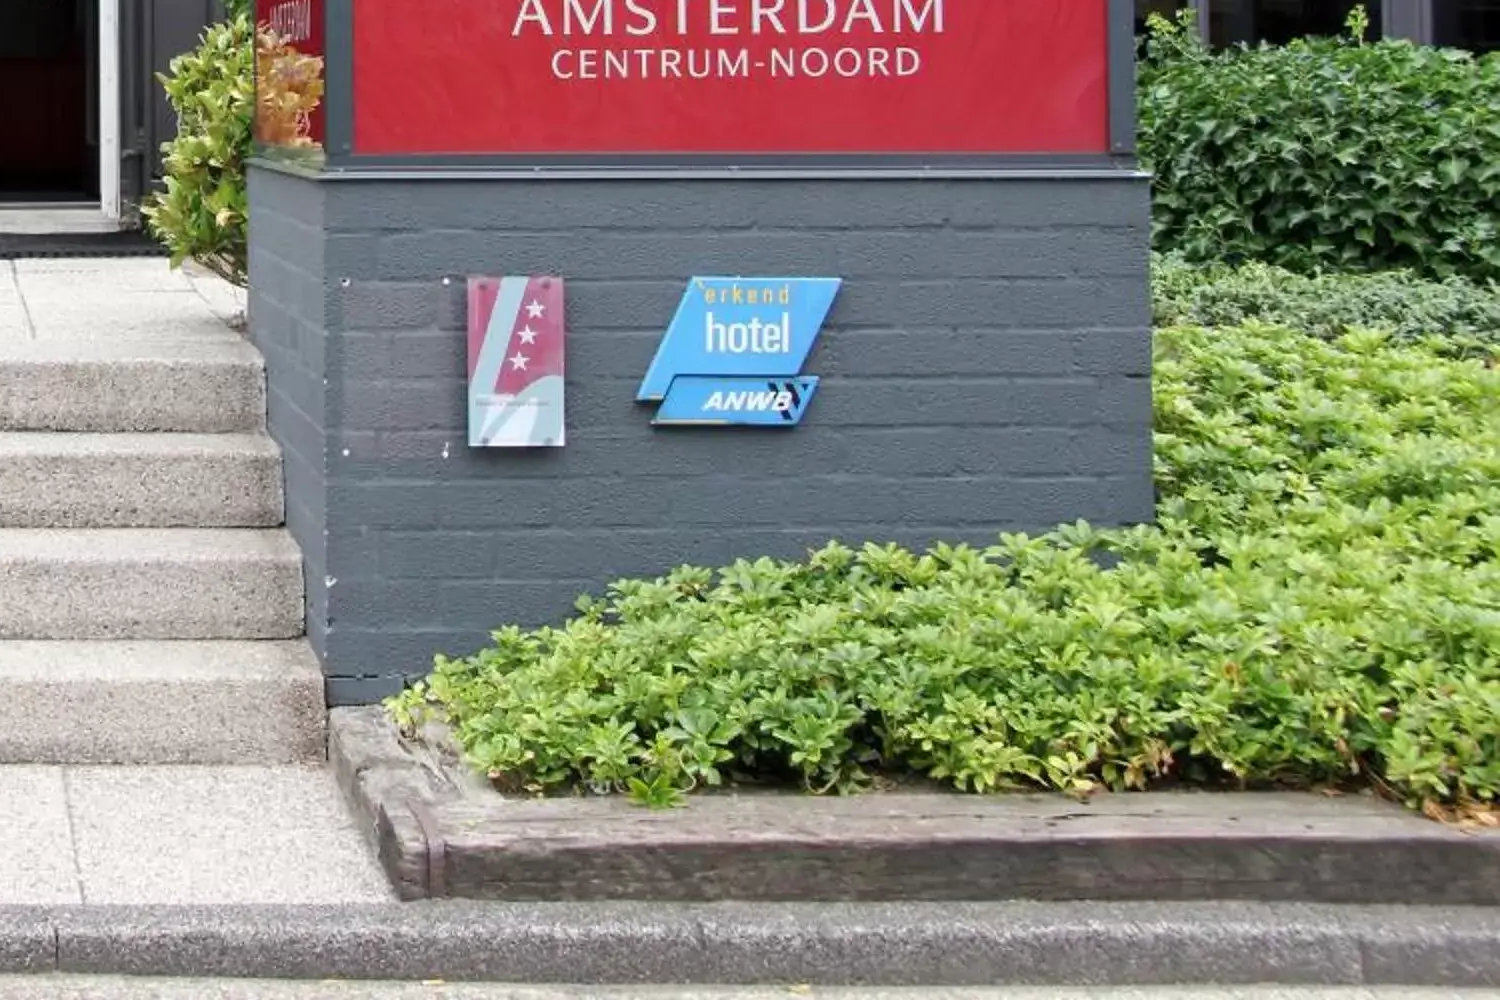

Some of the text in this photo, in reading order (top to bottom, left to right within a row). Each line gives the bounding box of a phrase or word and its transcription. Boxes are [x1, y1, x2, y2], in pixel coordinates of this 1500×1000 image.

[550, 47, 921, 80] CENTRUM-NOORD
[705, 283, 789, 305] erkend
[705, 311, 789, 353] hotel
[702, 390, 793, 412] ANWB
